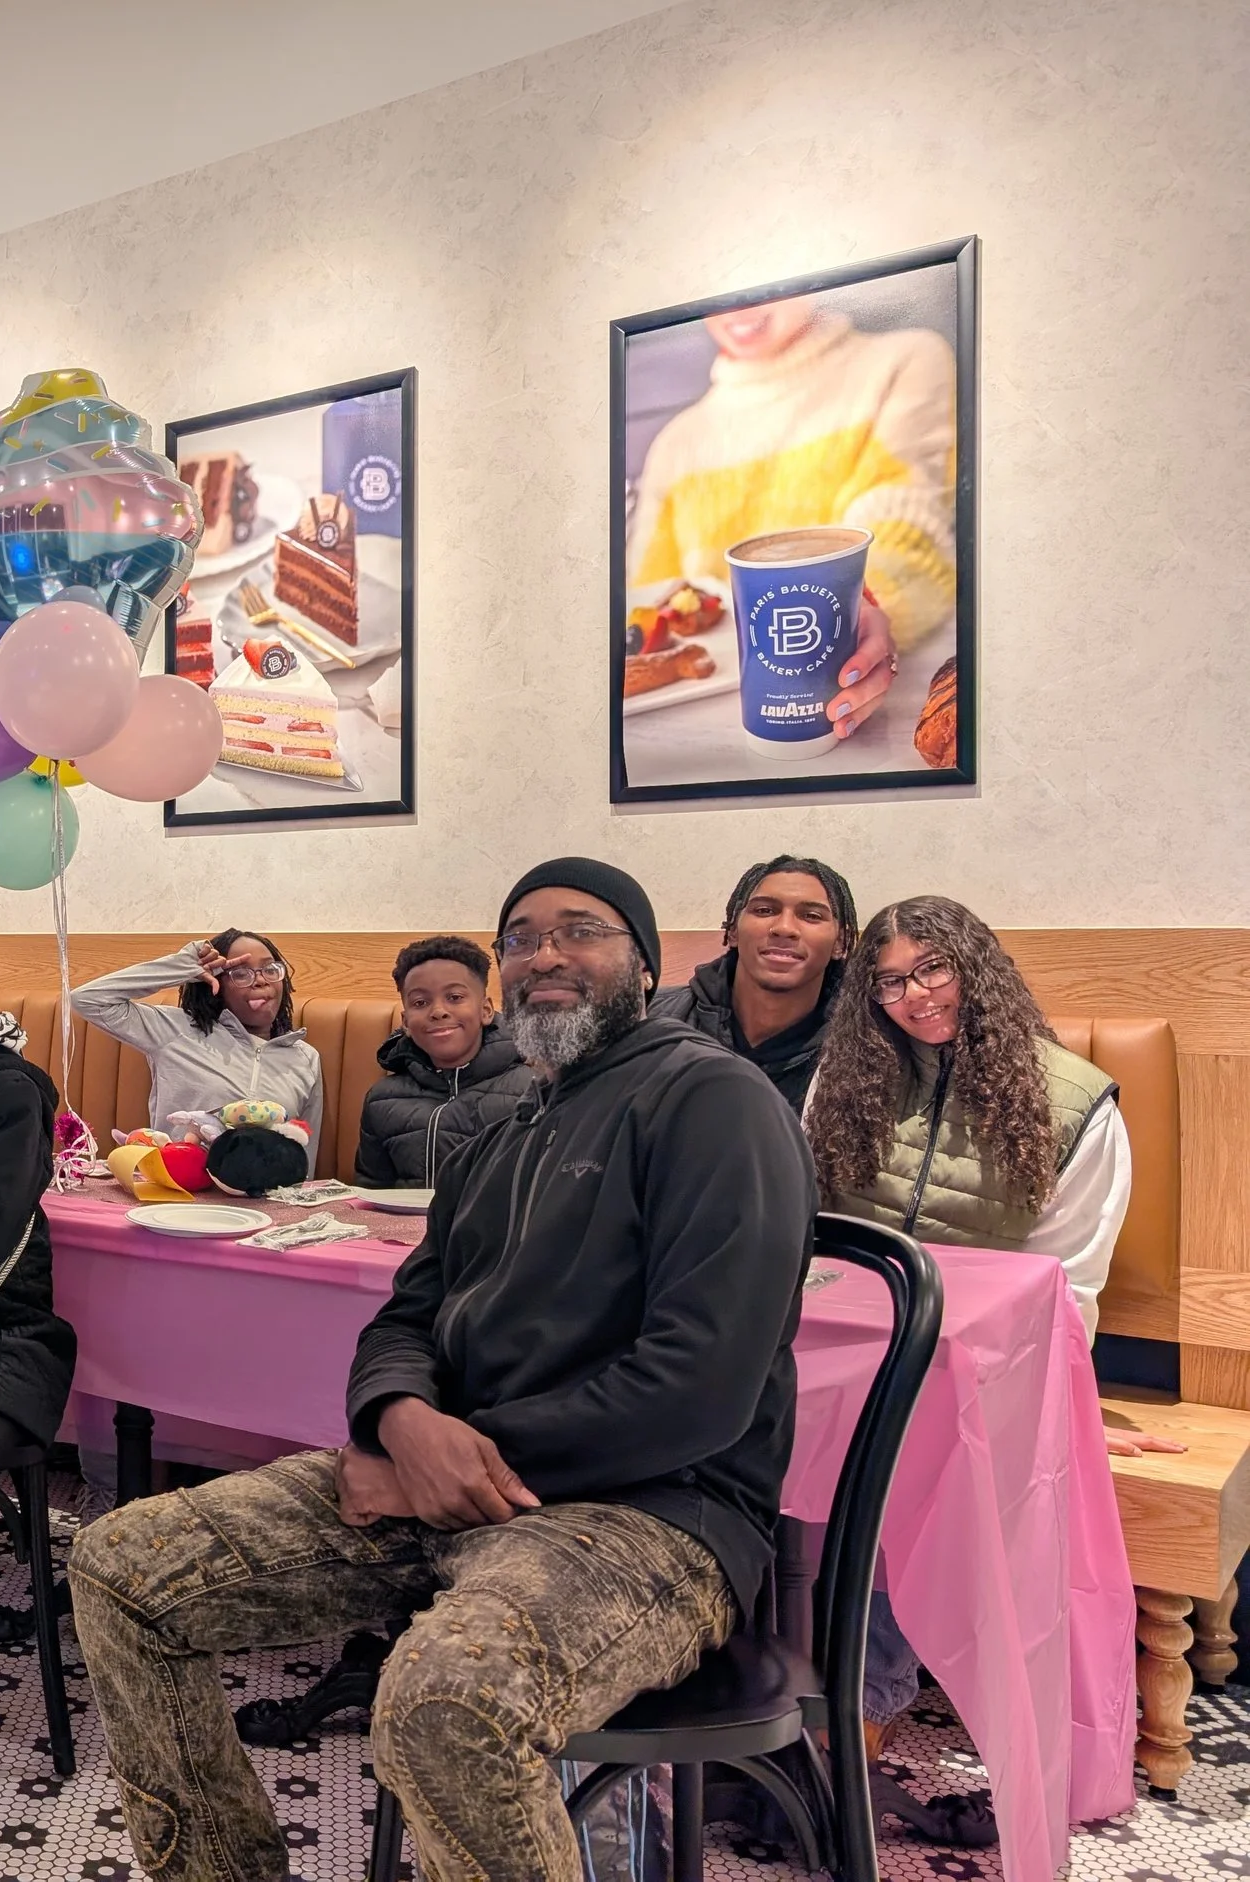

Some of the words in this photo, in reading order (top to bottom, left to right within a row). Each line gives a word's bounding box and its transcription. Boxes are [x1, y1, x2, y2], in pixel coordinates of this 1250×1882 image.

[750, 591, 775, 620] PARIS
[780, 584, 841, 611] BAGUETTE
[757, 652, 802, 676] BAKERY
[806, 644, 835, 672] CAFÉ
[760, 702, 824, 717] LAVAZZA
